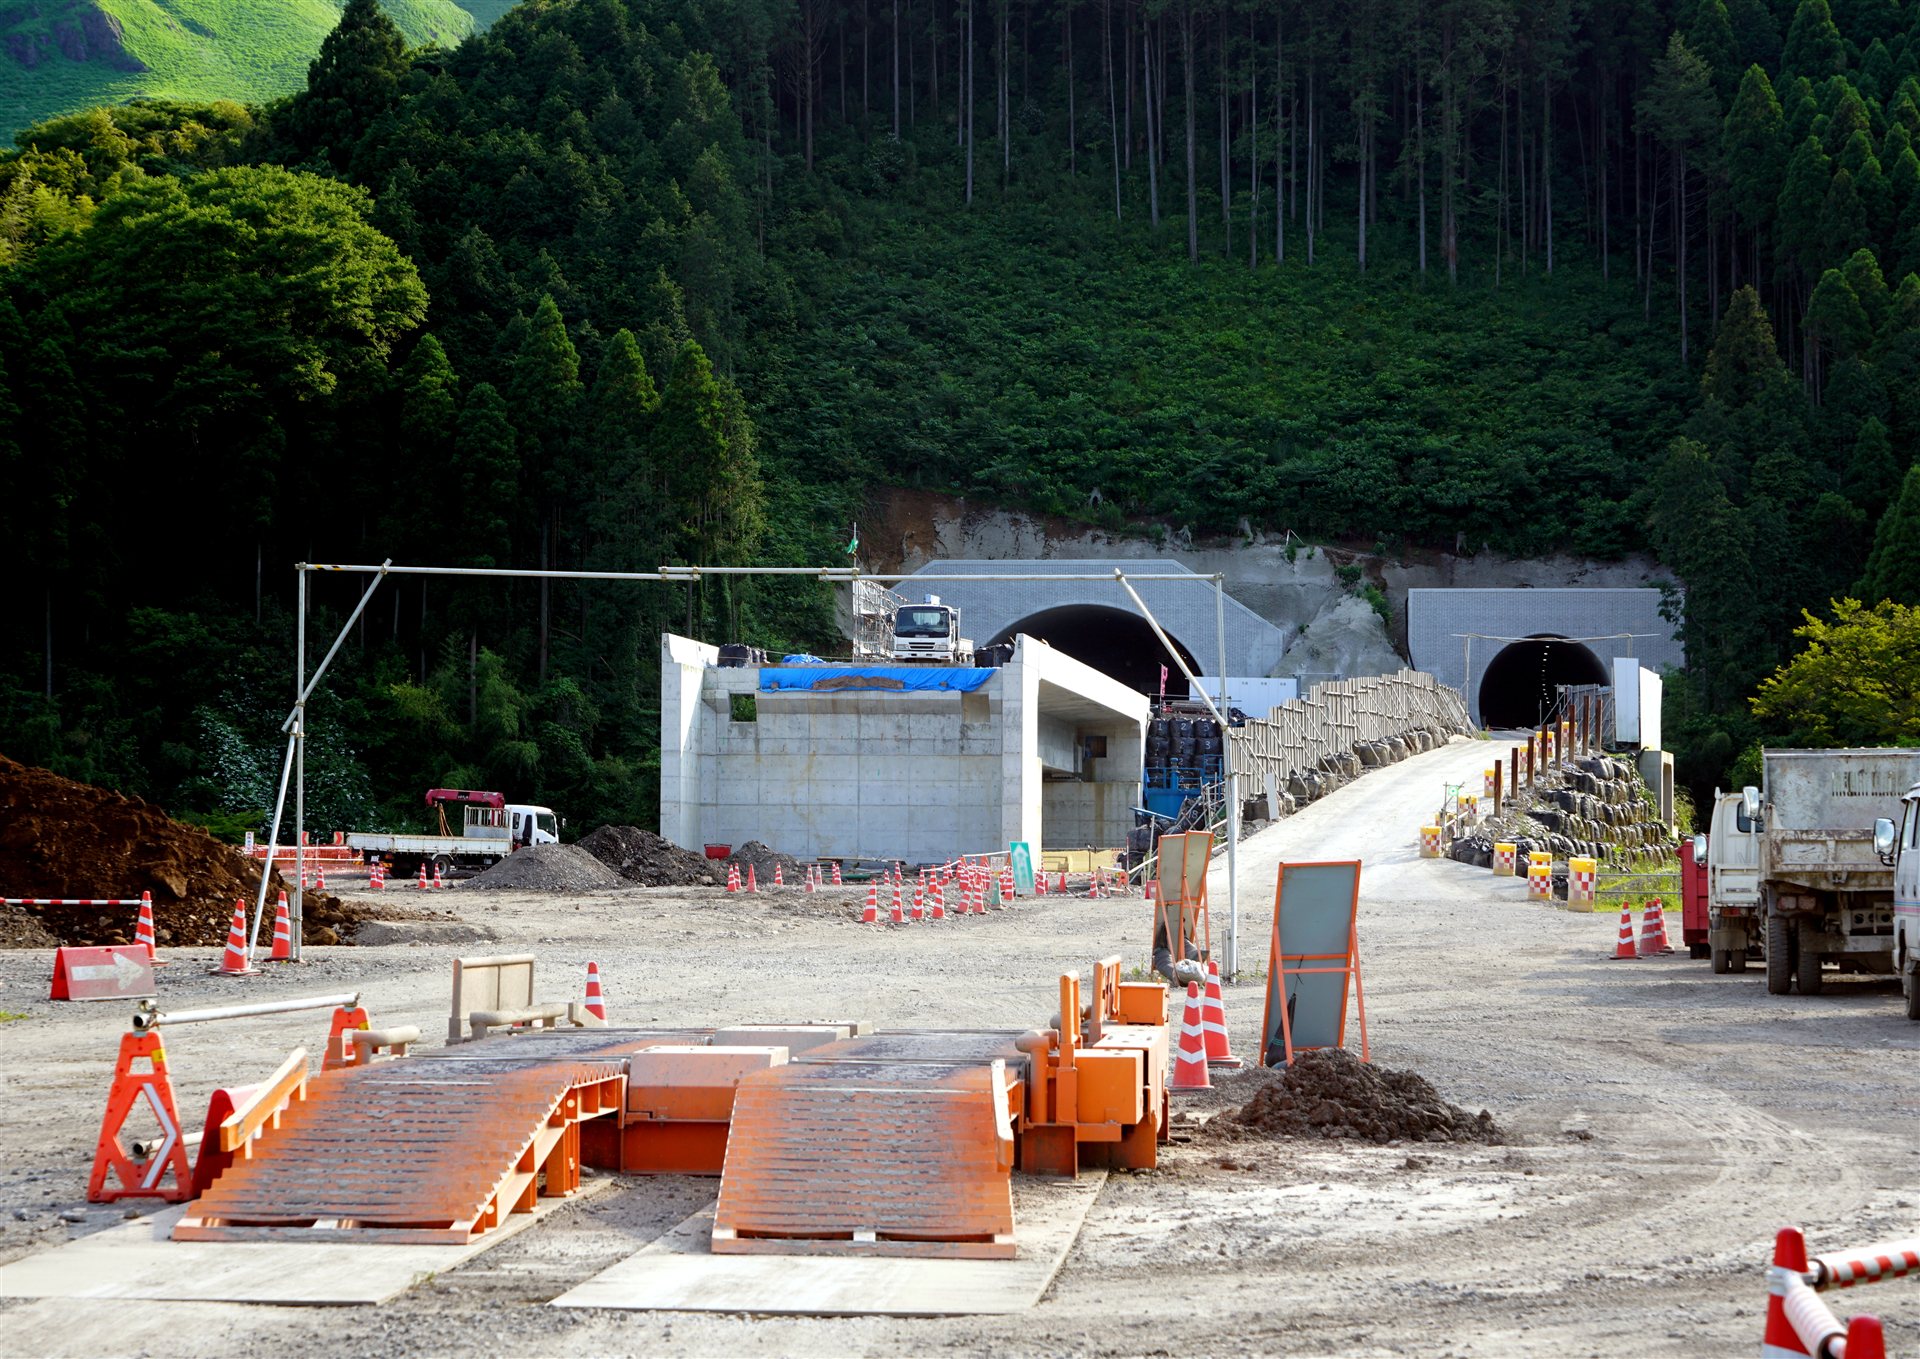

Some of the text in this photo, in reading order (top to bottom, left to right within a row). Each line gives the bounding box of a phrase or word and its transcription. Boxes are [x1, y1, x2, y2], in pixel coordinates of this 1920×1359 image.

[1180, 722, 1187, 731] 2
[1203, 722, 1210, 732] 3
[1205, 740, 1211, 750] 3
